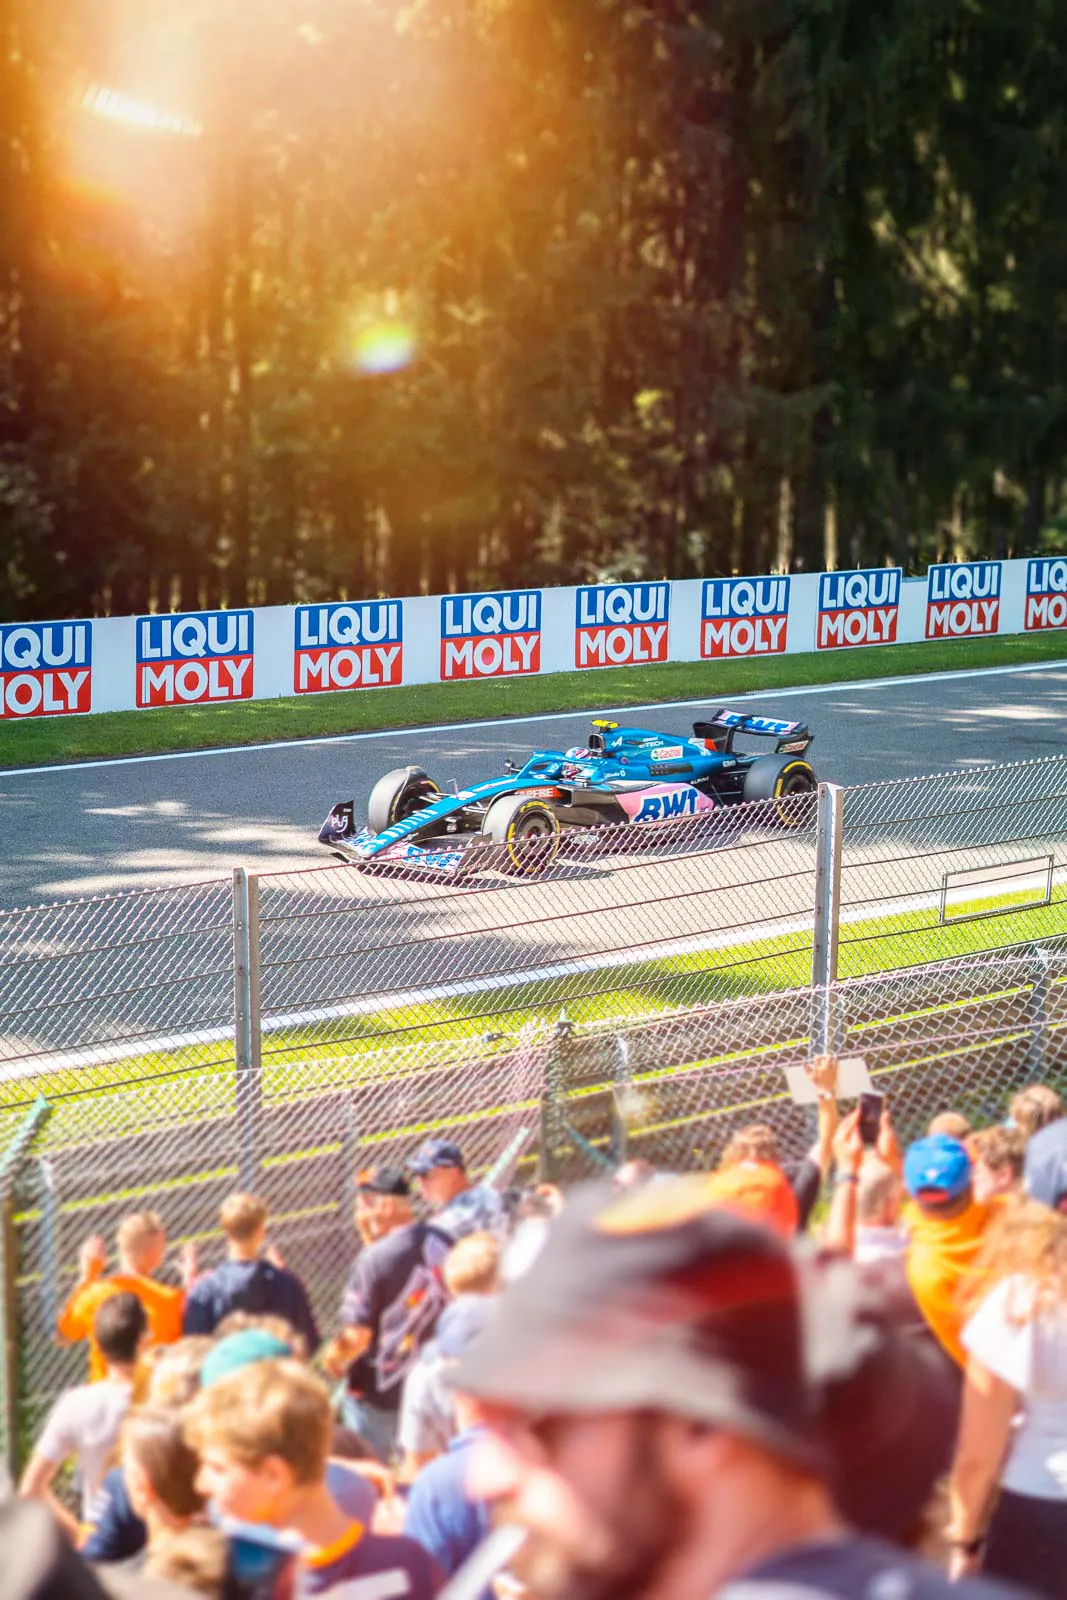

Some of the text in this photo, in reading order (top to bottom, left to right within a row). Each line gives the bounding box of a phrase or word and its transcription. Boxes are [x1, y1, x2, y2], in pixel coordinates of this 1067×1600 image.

[706, 580, 786, 616] LIQUI
[822, 571, 896, 608] LIQUI
[931, 563, 999, 600] LIQUI
[300, 604, 398, 646] LIQUI
[445, 594, 537, 635] LIQUI
[580, 587, 666, 625] LIQUI
[928, 600, 998, 637] MOLY
[0, 625, 86, 669] QUI
[141, 614, 249, 658] LIQUI
[579, 625, 668, 665] MOLY
[704, 617, 786, 656] MOLY
[820, 608, 897, 648] MOLY
[299, 645, 402, 689] MOLY
[445, 634, 540, 677] MOLY
[0, 671, 90, 715] OLY
[141, 657, 253, 704] MOLY
[633, 788, 699, 822] BWT
